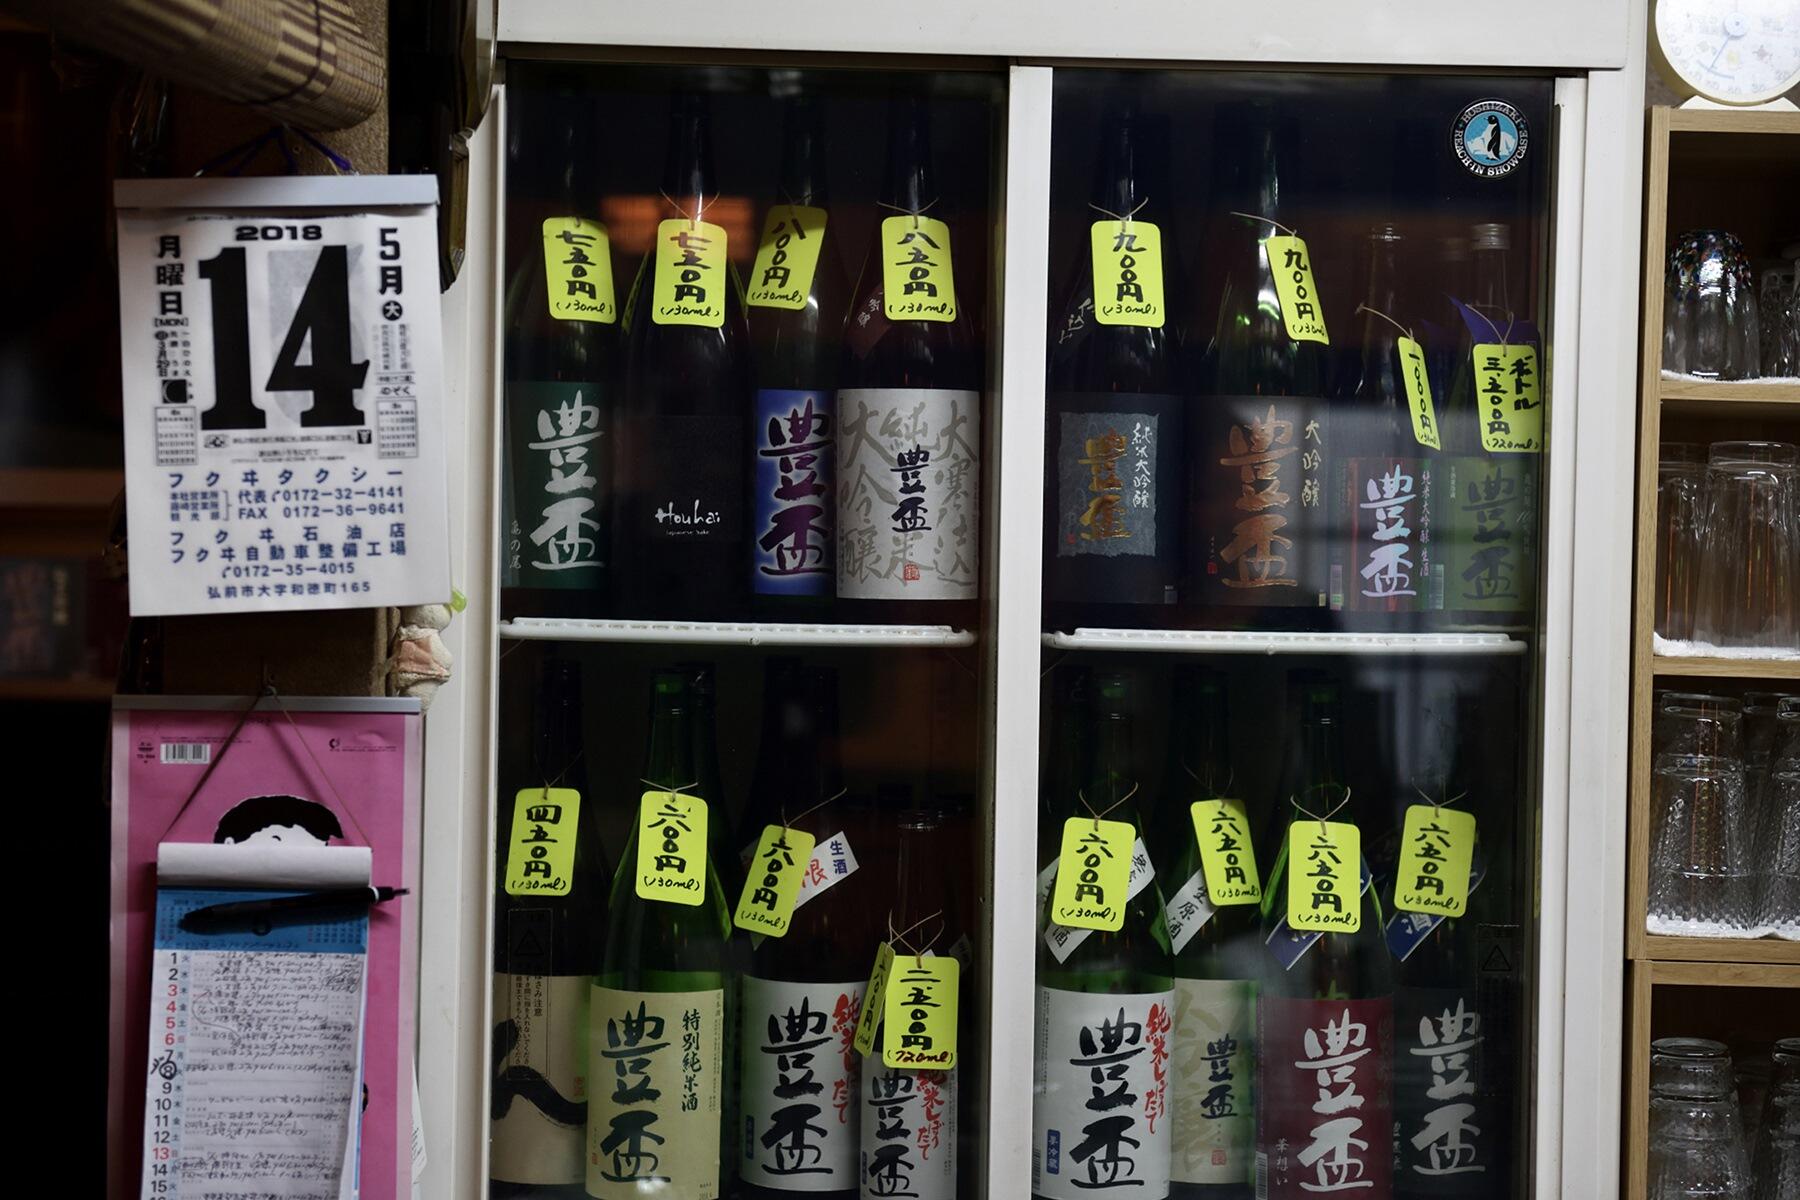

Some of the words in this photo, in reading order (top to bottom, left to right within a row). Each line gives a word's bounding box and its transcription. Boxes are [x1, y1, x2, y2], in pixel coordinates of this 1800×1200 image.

[1462, 102, 1522, 124] HOSHIZAKI
[1487, 130, 1528, 176] SHOWCASE
[235, 225, 322, 242] 2018
[379, 227, 403, 295] 5月
[156, 235, 185, 315] 月曜日
[198, 245, 370, 429] 14
[1302, 420, 1321, 507] 大吟醸
[169, 468, 403, 488] フクヰタクシー
[238, 491, 265, 503] 代表
[239, 508, 268, 519] FAX
[654, 499, 721, 525] Houhai
[171, 523, 406, 545] フクヰ石油店
[171, 541, 406, 563] フクヰ自動車整備工場
[830, 840, 848, 874] 生酒
[171, 952, 177, 964] 1
[168, 968, 178, 981] 2
[168, 984, 177, 997] 3
[166, 1001, 177, 1013] 4
[166, 1017, 175, 1029] 5
[165, 1033, 175, 1045] 6
[165, 1049, 174, 1062] 7
[681, 1008, 702, 1113] 特別純米酒
[163, 1065, 173, 1077] 8
[1200, 1033, 1238, 1119] 豊盃
[162, 1082, 172, 1094] 9
[600, 1000, 671, 1183] 豊盃
[760, 996, 834, 1176] 豊盃
[1410, 997, 1486, 1176] 豊盃
[155, 1098, 171, 1110] 10
[1069, 1007, 1146, 1189] 豊盃
[1294, 1007, 1374, 1192] 豊盃
[155, 1115, 168, 1127] 11
[154, 1131, 170, 1143] 12
[153, 1148, 169, 1160] 13
[152, 1164, 167, 1176] 14
[151, 1180, 167, 1192] 15
